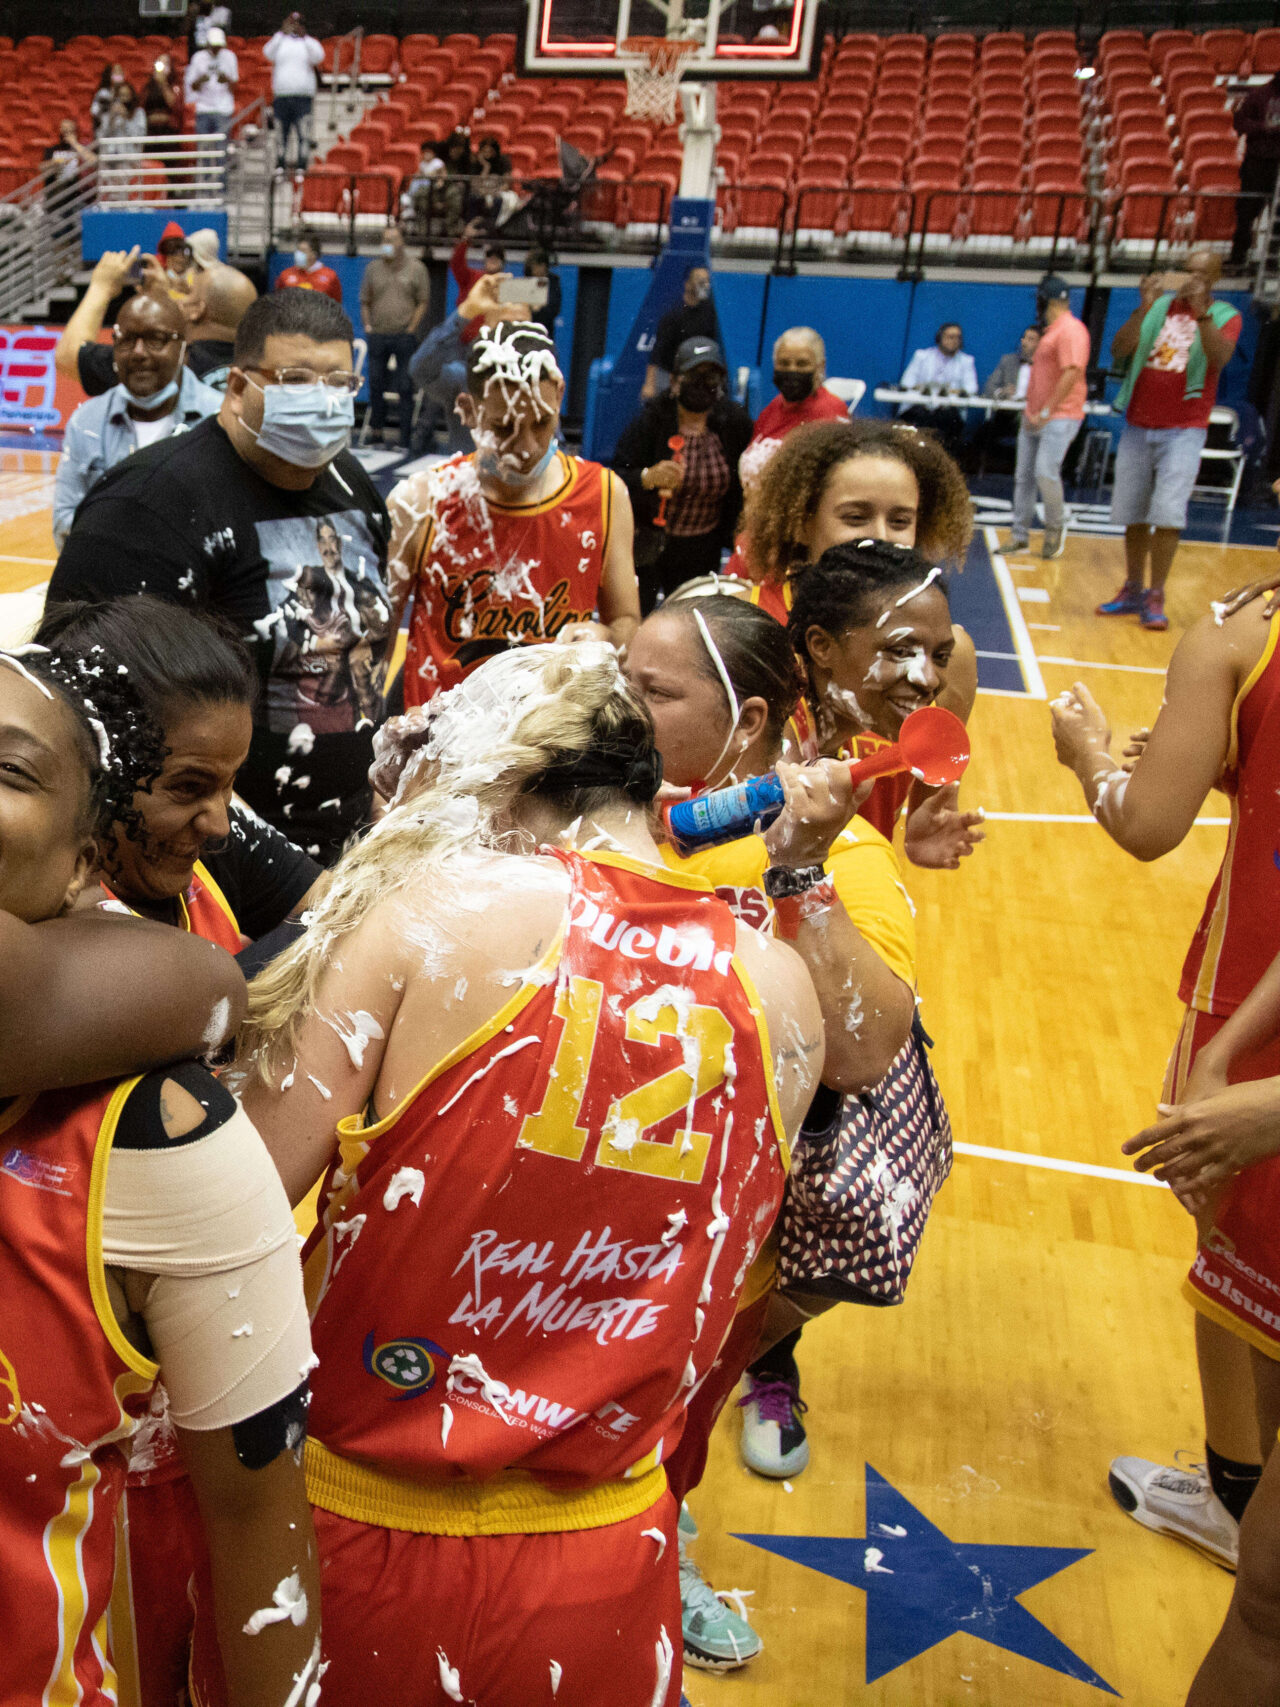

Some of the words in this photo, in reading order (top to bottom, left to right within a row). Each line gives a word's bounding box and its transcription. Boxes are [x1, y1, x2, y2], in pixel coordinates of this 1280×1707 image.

[515, 975, 735, 1184] 12
[451, 1229, 554, 1308] REAL
[560, 1225, 686, 1289] HASTA
[448, 1291, 504, 1330] LA
[494, 1281, 669, 1345] MUERTE
